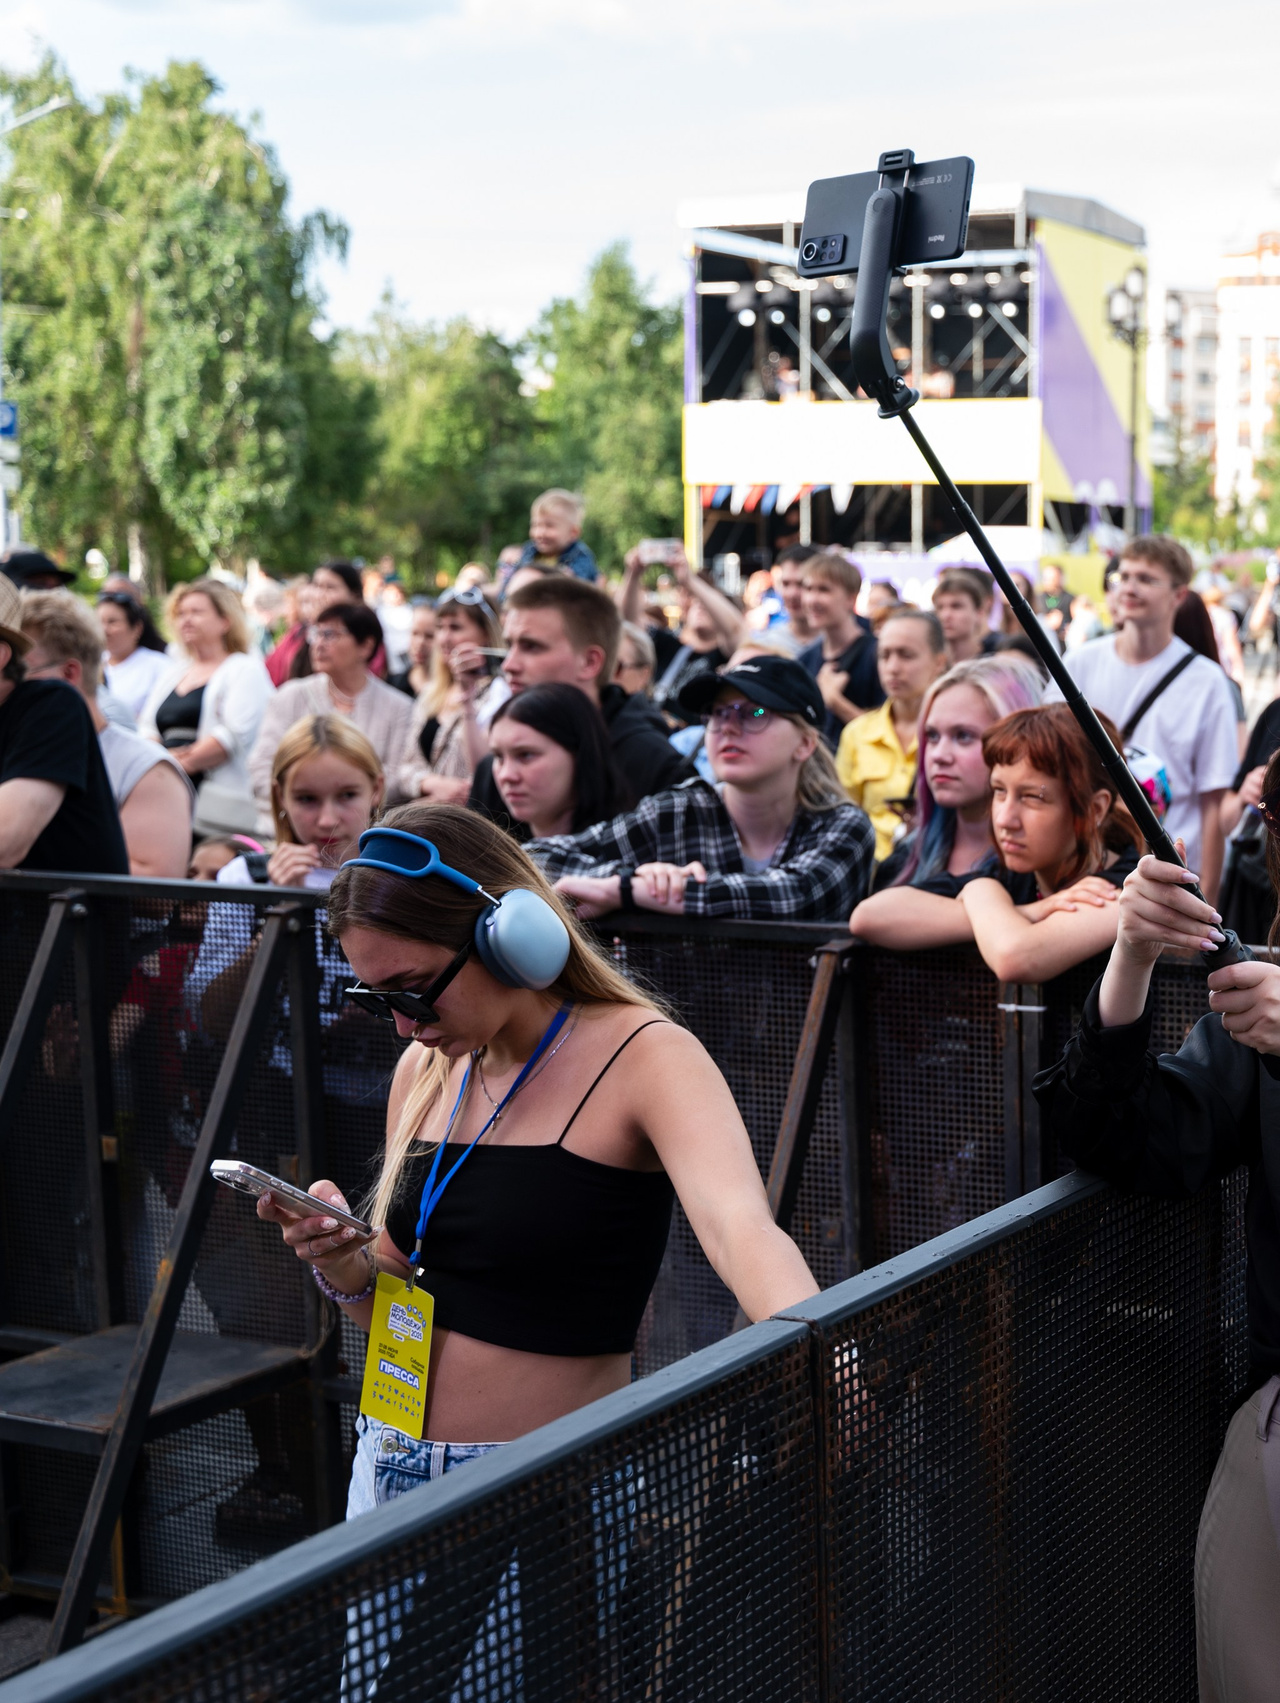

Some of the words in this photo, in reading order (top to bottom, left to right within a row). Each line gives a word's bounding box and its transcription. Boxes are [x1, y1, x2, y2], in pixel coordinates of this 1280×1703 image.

[928, 234, 945, 244] Redmi
[391, 1304, 407, 1316] ДЕНЬ
[391, 1312, 422, 1331] МОЛОДЁЖИ
[411, 1329, 422, 1340] 2025
[379, 1359, 420, 1390] ПРЕССА
